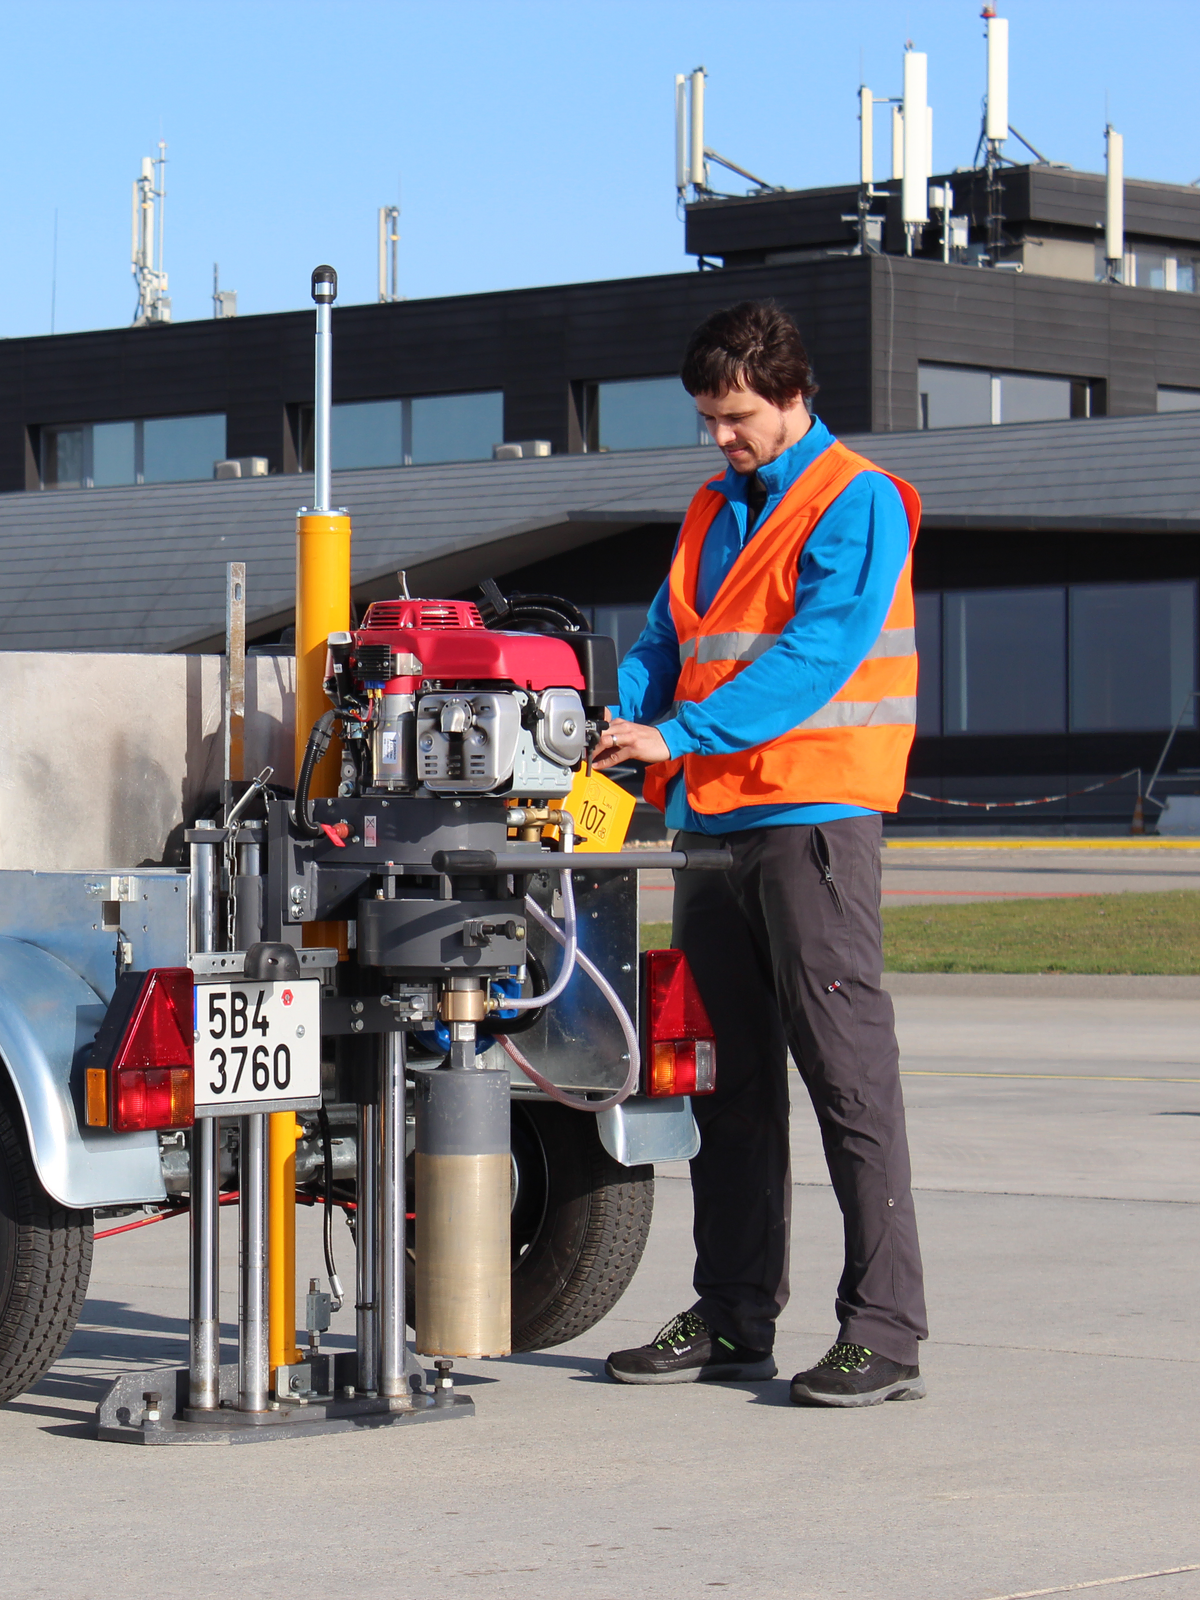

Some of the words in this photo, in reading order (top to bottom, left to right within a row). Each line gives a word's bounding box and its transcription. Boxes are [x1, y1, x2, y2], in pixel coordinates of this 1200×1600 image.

[580, 800, 606, 834] 107
[209, 990, 269, 1040] 5B4
[209, 1043, 291, 1095] 3760
